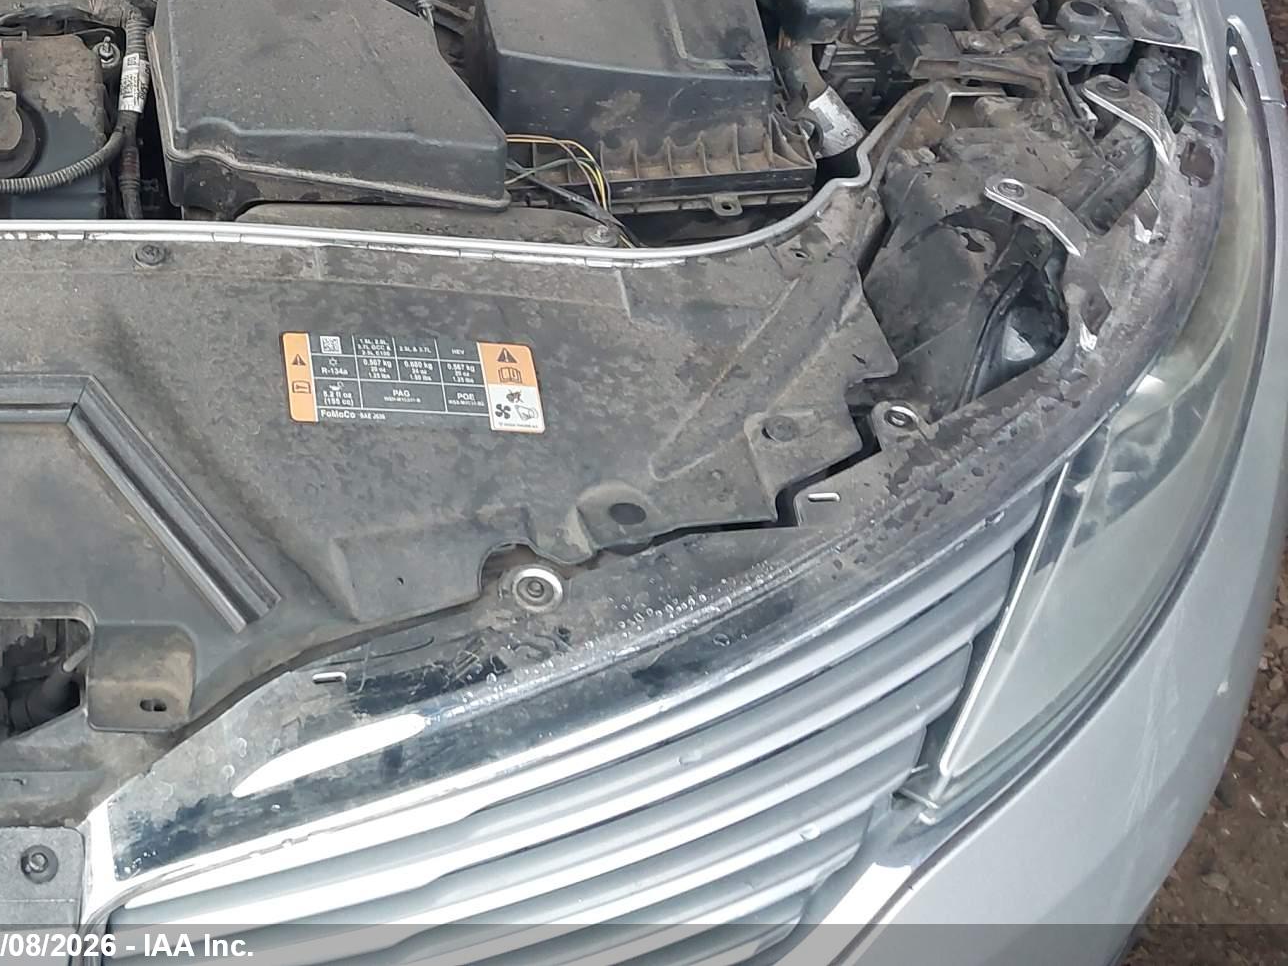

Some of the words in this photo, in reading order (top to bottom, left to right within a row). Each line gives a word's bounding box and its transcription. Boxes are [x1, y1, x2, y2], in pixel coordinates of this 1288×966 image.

[321, 367, 348, 375] R-134a
[392, 389, 411, 398] PAG
[320, 410, 356, 418] FoMoCo
